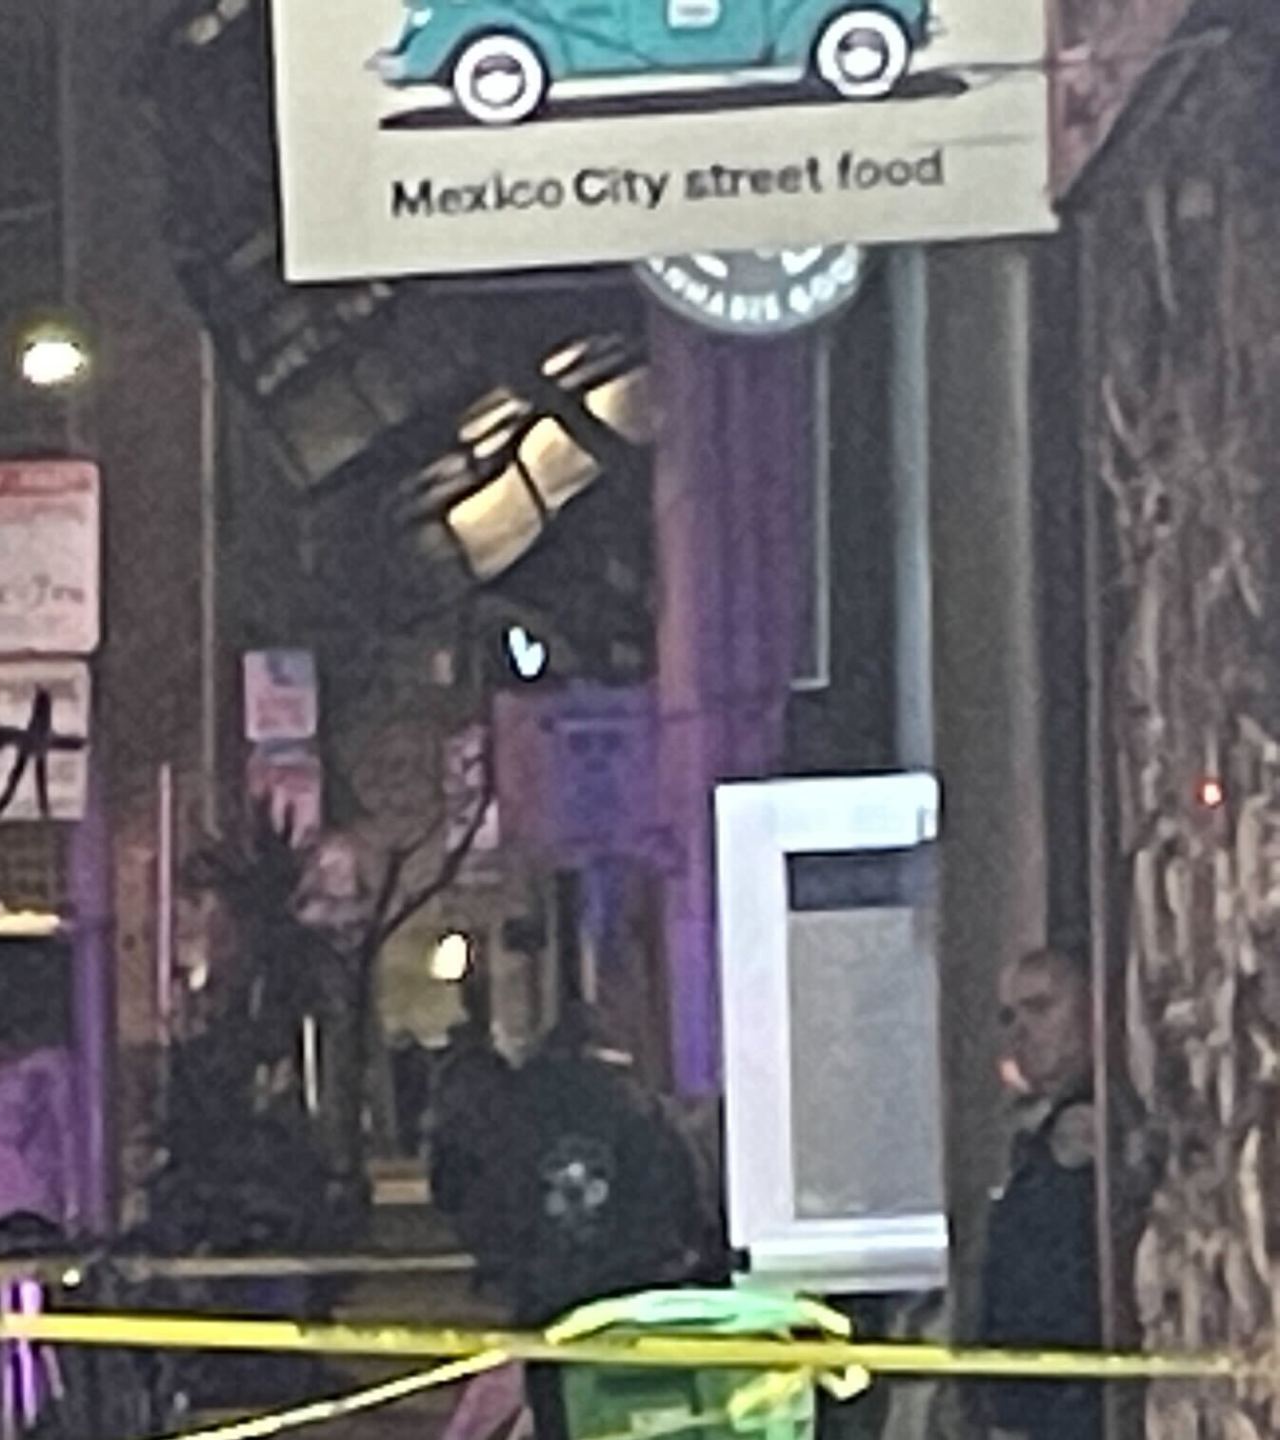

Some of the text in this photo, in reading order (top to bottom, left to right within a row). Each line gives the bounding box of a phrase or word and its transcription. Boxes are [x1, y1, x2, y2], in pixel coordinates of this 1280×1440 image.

[392, 147, 946, 219] Mexico City street food
